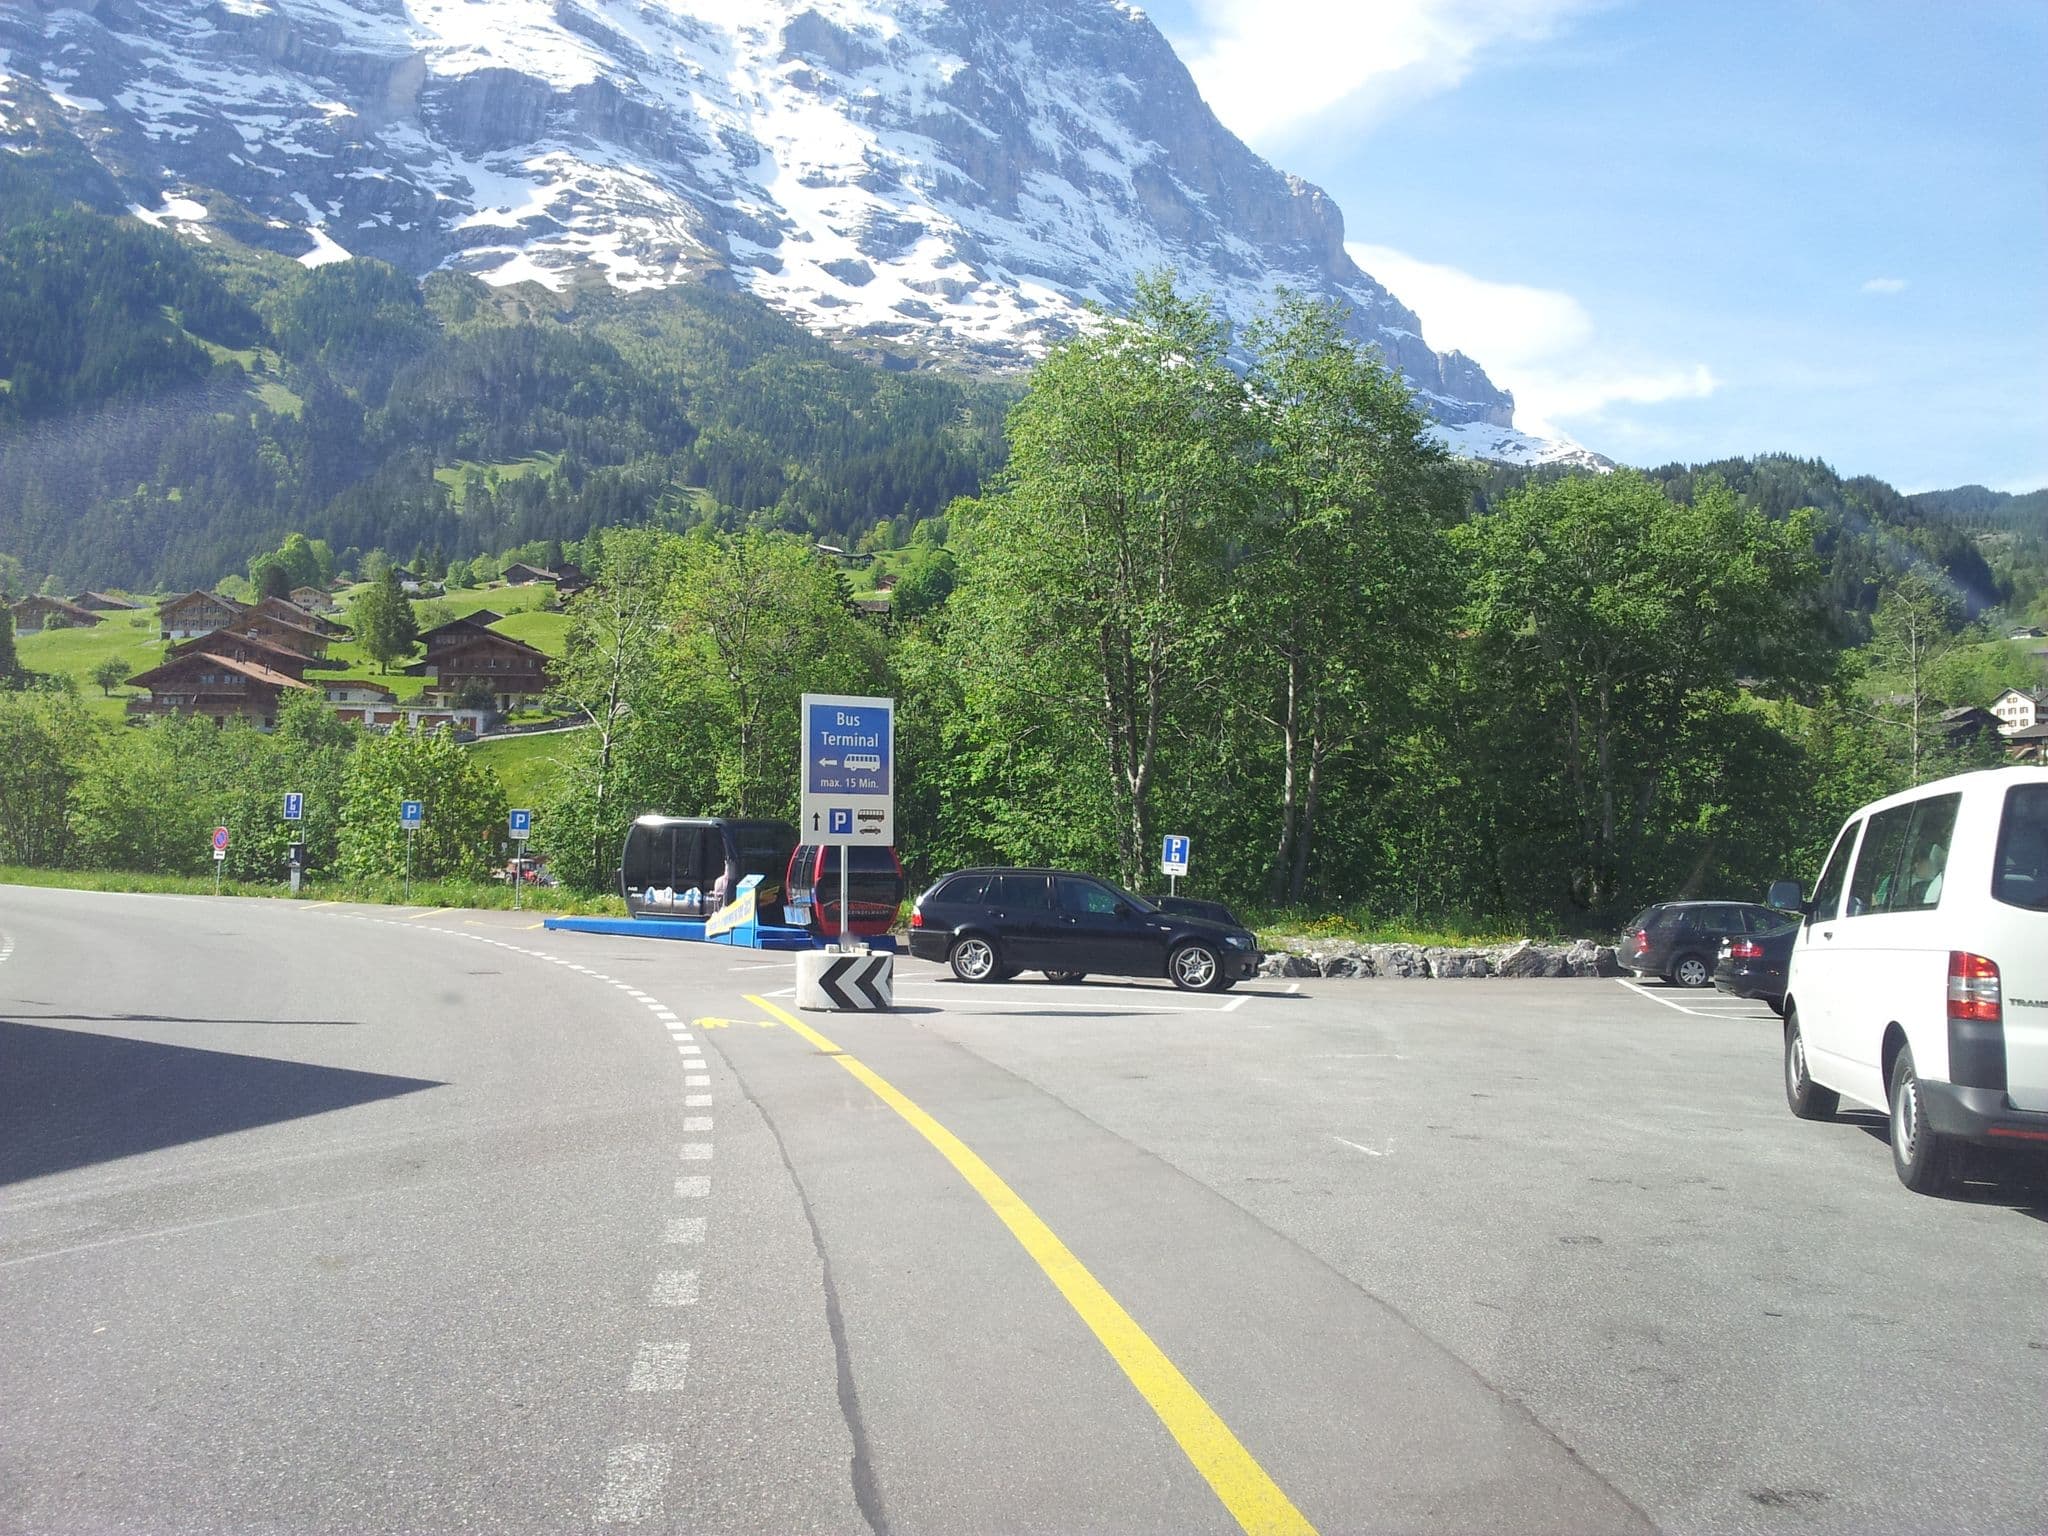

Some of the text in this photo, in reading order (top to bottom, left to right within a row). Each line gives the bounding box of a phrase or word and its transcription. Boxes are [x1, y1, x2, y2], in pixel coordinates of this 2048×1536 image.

[836, 711, 861, 727] Bus
[821, 731, 879, 748] Terminal
[820, 777, 879, 789] max. 15 Min.
[407, 805, 417, 819] P
[515, 813, 526, 828] P
[834, 811, 847, 831] P
[1172, 839, 1181, 852] P
